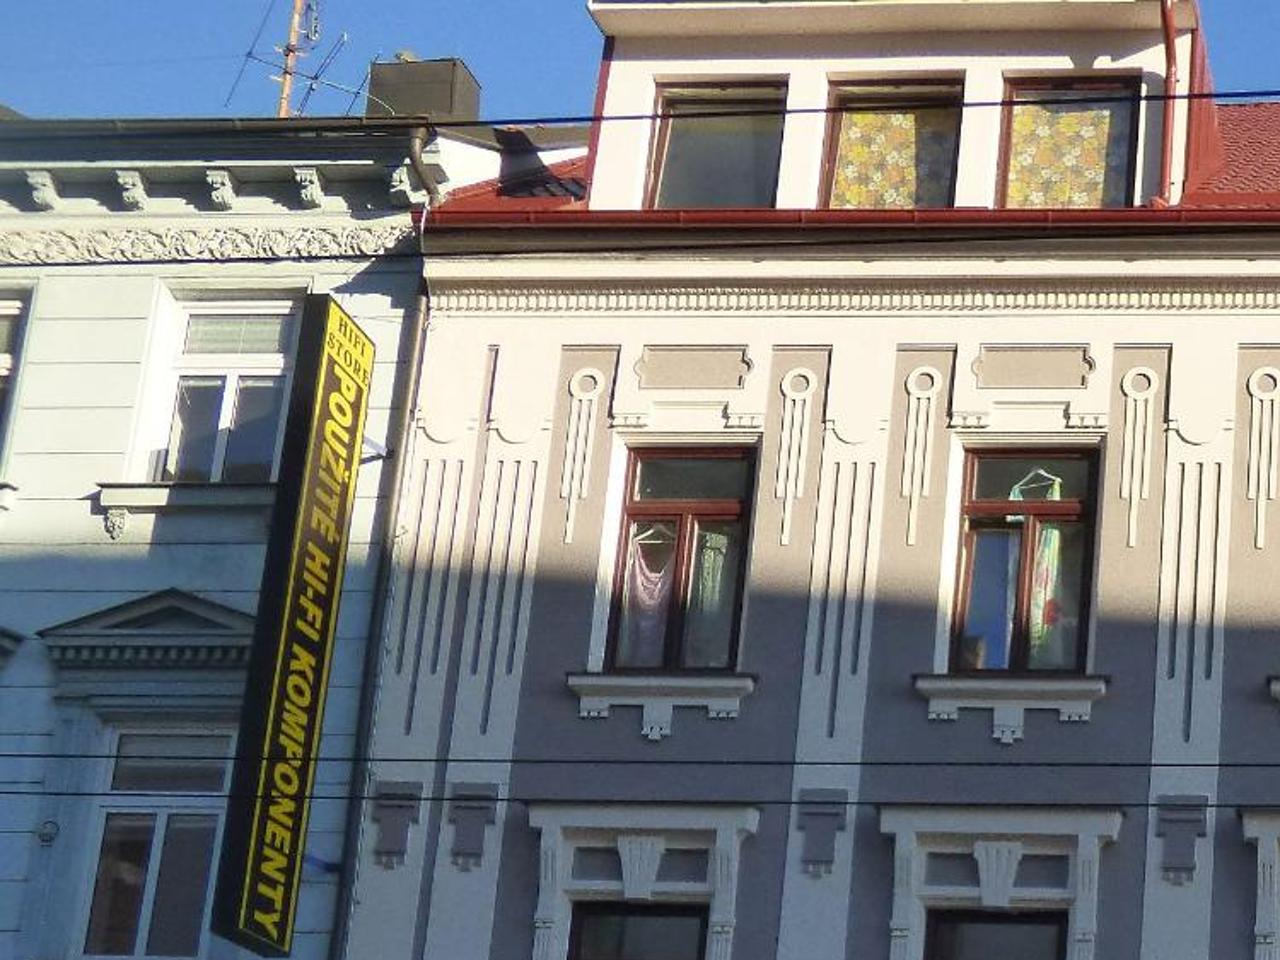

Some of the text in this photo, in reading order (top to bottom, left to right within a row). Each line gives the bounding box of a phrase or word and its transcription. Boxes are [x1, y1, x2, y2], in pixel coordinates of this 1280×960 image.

[327, 332, 369, 387] STORE
[338, 315, 366, 357] HIFI
[295, 541, 331, 641] HI-FI
[253, 643, 317, 941] KOMPONENTY
